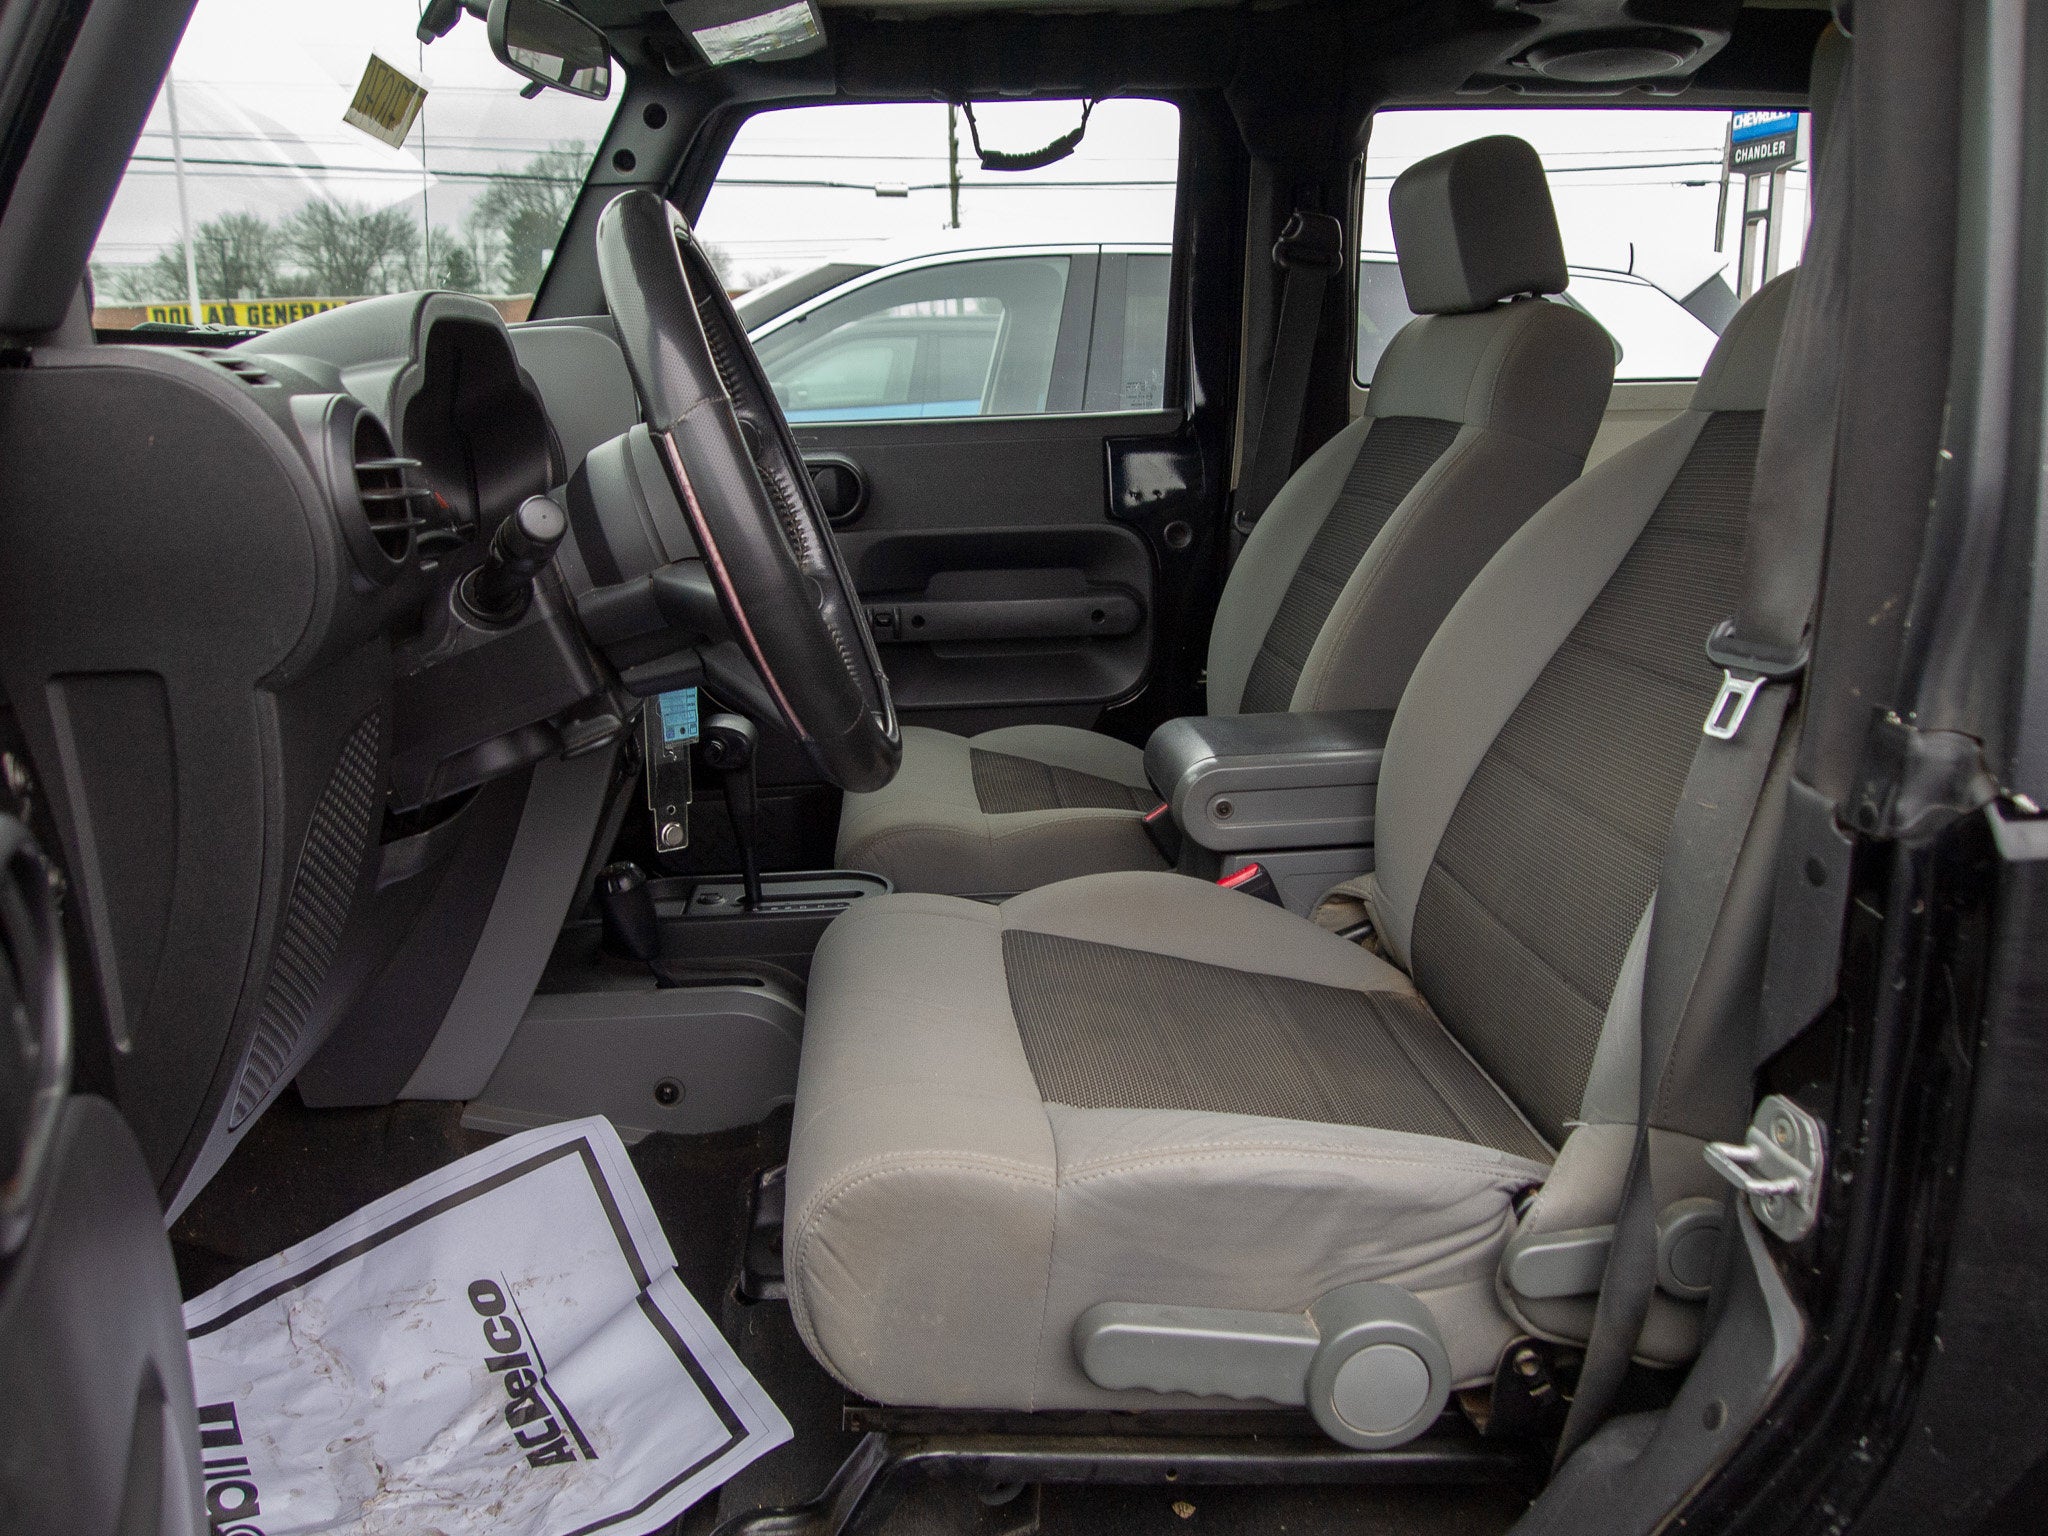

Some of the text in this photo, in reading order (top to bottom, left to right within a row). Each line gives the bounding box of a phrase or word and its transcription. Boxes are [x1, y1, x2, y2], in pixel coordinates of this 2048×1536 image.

[1735, 140, 1786, 163] CHANDLER
[152, 303, 339, 326] DOLAR GENER
[468, 1279, 577, 1468] ACDelco
